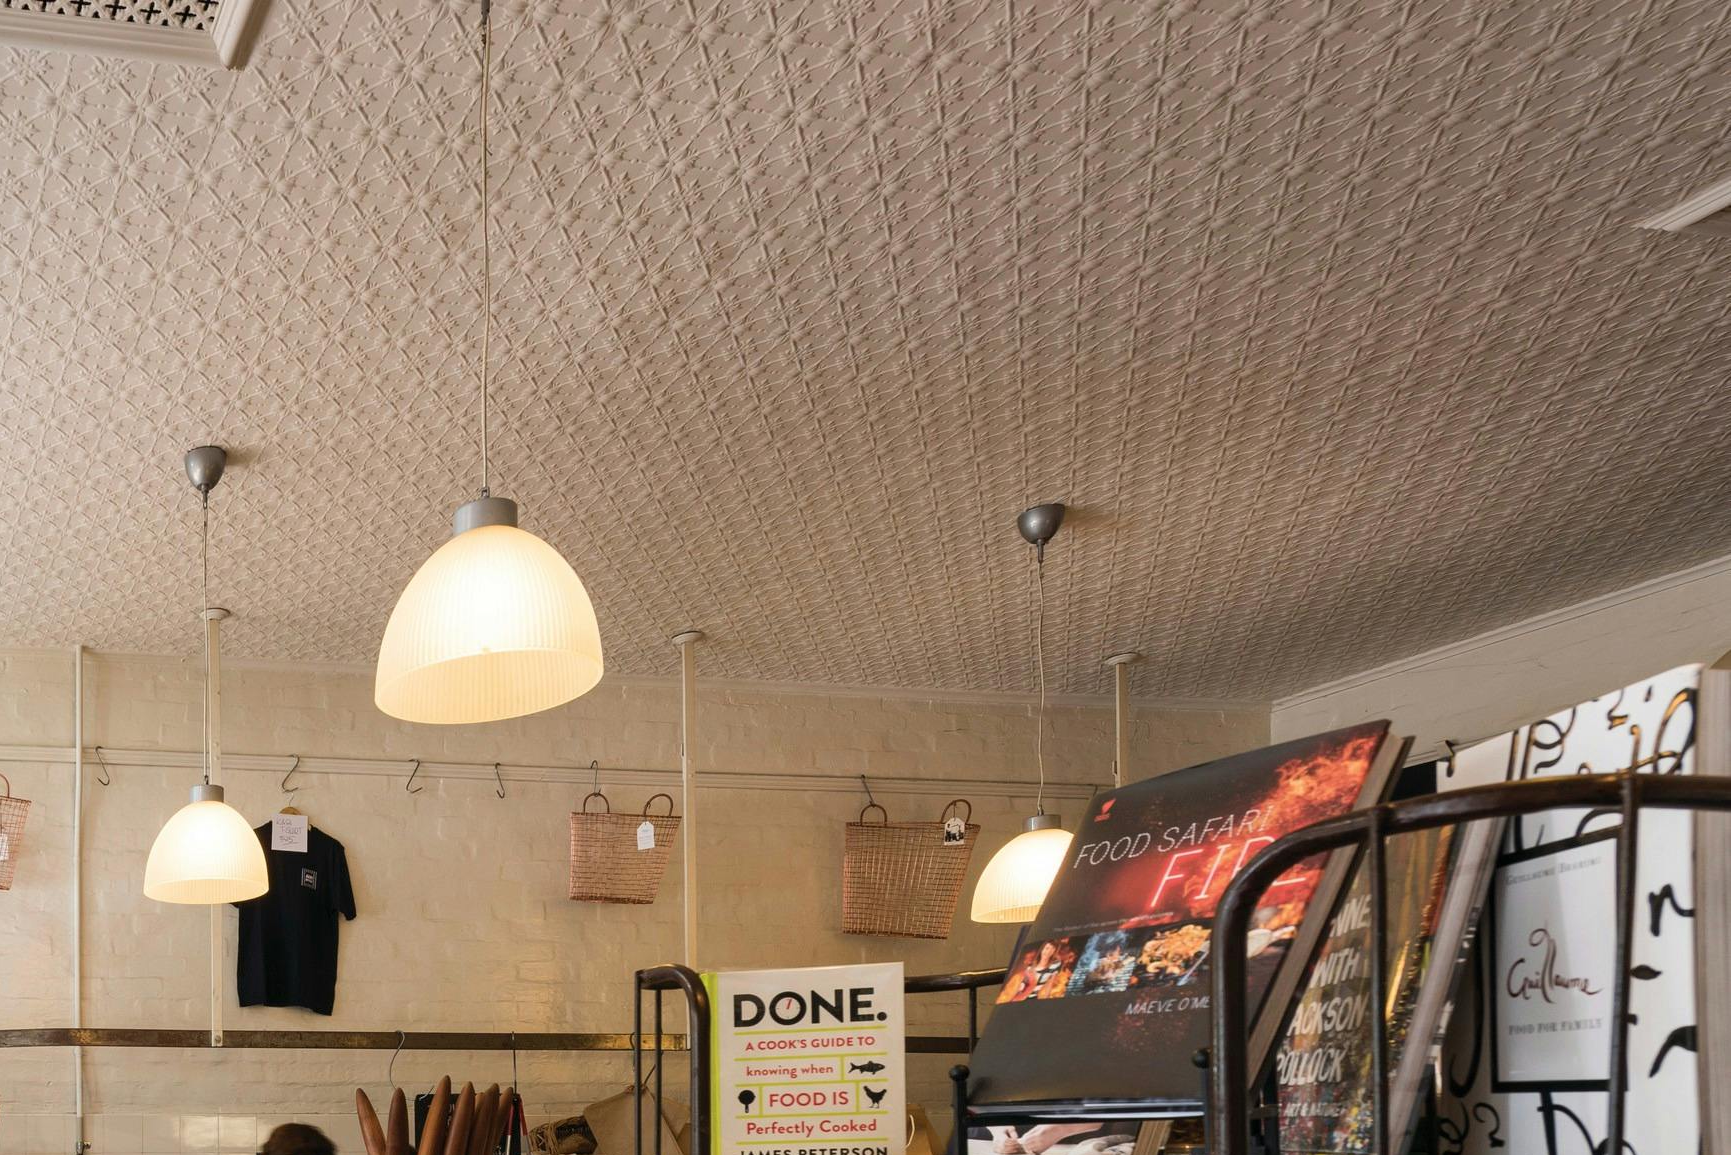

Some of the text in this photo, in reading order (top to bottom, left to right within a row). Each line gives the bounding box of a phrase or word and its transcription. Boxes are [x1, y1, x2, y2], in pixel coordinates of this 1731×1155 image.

[1073, 805, 1275, 869] FOOD SAFARI
[1309, 947, 1360, 988] WITH
[733, 987, 888, 1028] DONE.
[1125, 995, 1211, 1015] MAEVE O'ME
[1286, 991, 1370, 1036] ACKSON
[745, 1036, 876, 1051] A COOK'S GUIDE TO
[745, 1064, 834, 1079] knowing when
[769, 1091, 849, 1107] FOOD IS
[747, 1119, 877, 1139] Perfectly Cooked
